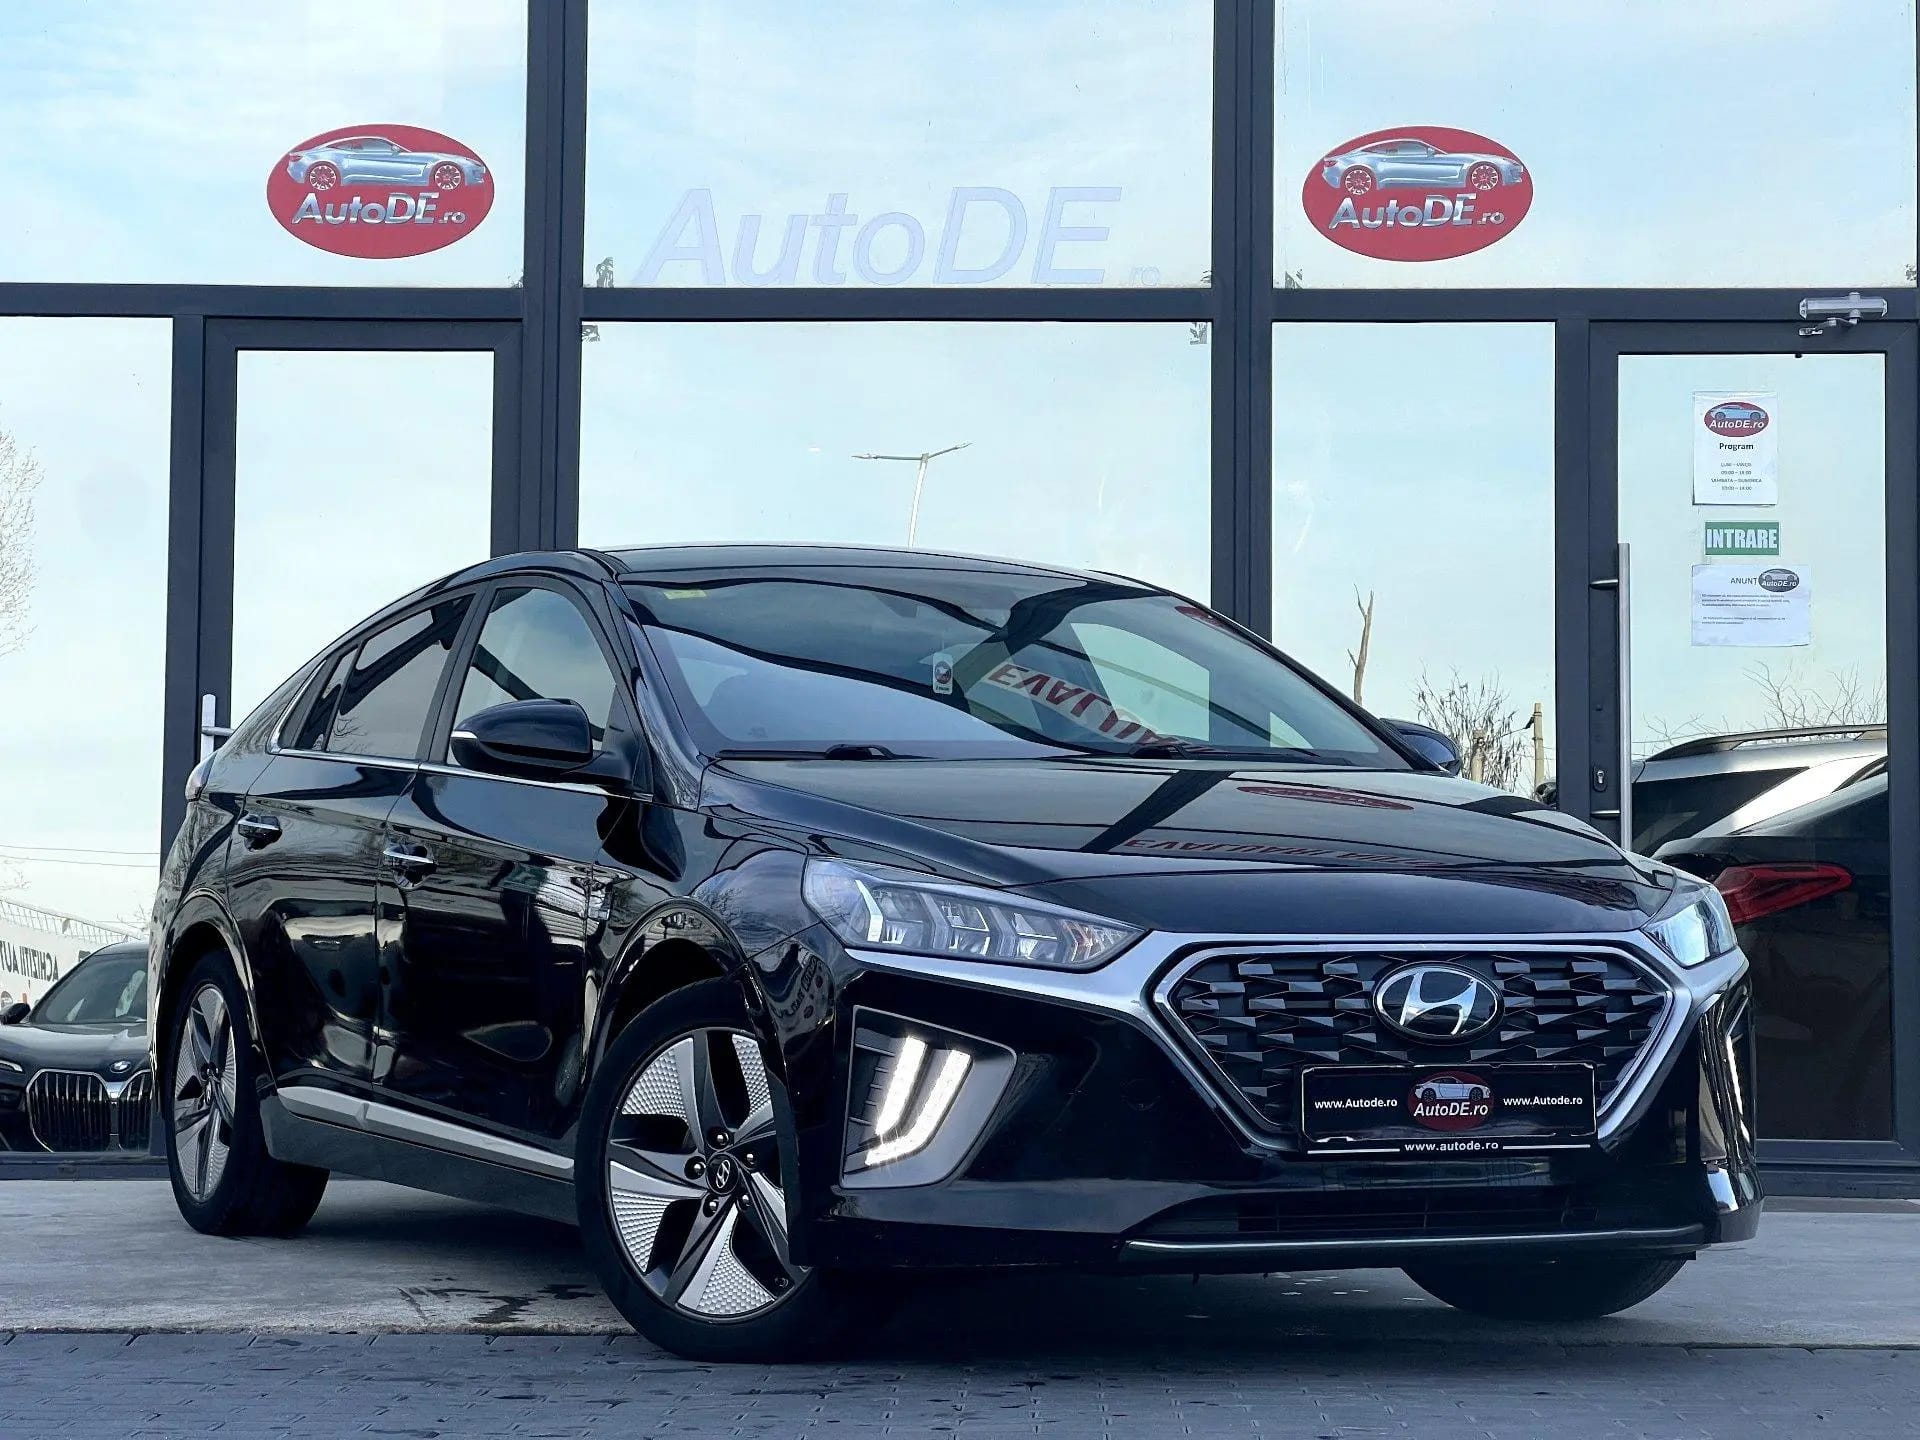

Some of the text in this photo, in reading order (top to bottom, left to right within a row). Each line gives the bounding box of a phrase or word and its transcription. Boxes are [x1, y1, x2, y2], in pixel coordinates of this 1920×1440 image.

[291, 192, 466, 225] AutoDE.ro
[1328, 193, 1505, 229] AutoDE.ro
[1709, 420, 1765, 429] AutoDE.ro
[1719, 443, 1754, 451] Program
[1706, 528, 1778, 549] INTRARE
[1314, 1097, 1398, 1109] www.Autode.ro
[1503, 1095, 1583, 1107] www.Autode.ro
[1413, 1101, 1489, 1117] AutoDE.ro
[1404, 1140, 1499, 1151] www.autode.ro
